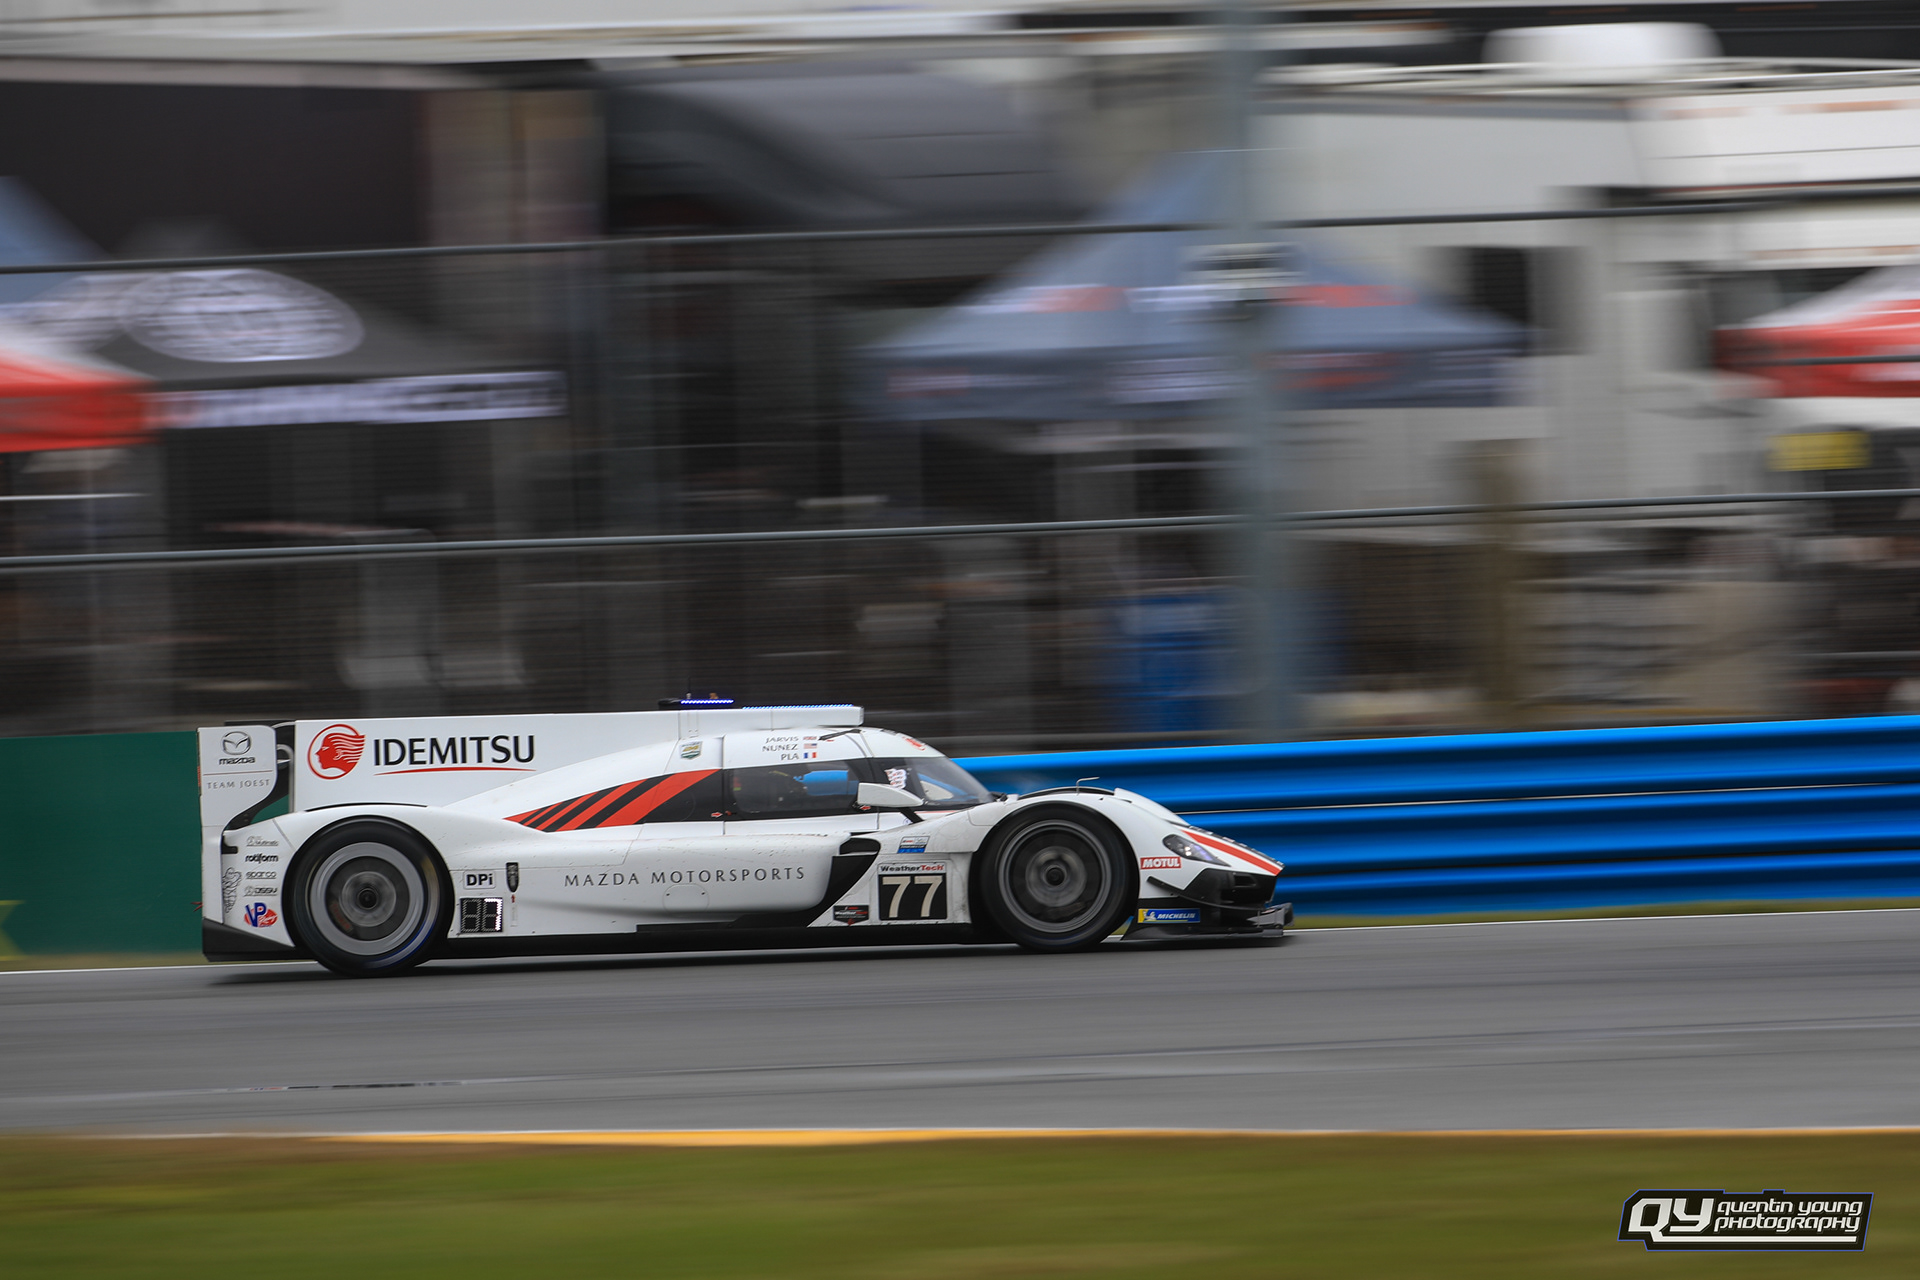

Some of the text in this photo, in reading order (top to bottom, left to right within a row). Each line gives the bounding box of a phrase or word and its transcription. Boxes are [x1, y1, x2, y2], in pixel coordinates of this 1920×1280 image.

[765, 736, 799, 744] JARVIS
[374, 735, 535, 766] IDEMITSU
[218, 756, 256, 766] mazda
[781, 752, 800, 761] PLA
[207, 779, 271, 790] TEAM JOEST
[245, 853, 279, 865] rotiform
[1142, 858, 1180, 868] MOTUL
[880, 864, 945, 872] WeatherTech
[466, 873, 494, 887] DPi
[564, 867, 805, 887] MAZDA MOTORSPORTS
[882, 875, 943, 918] 77
[245, 902, 267, 928] VP
[1157, 912, 1196, 920] MICHELIN
